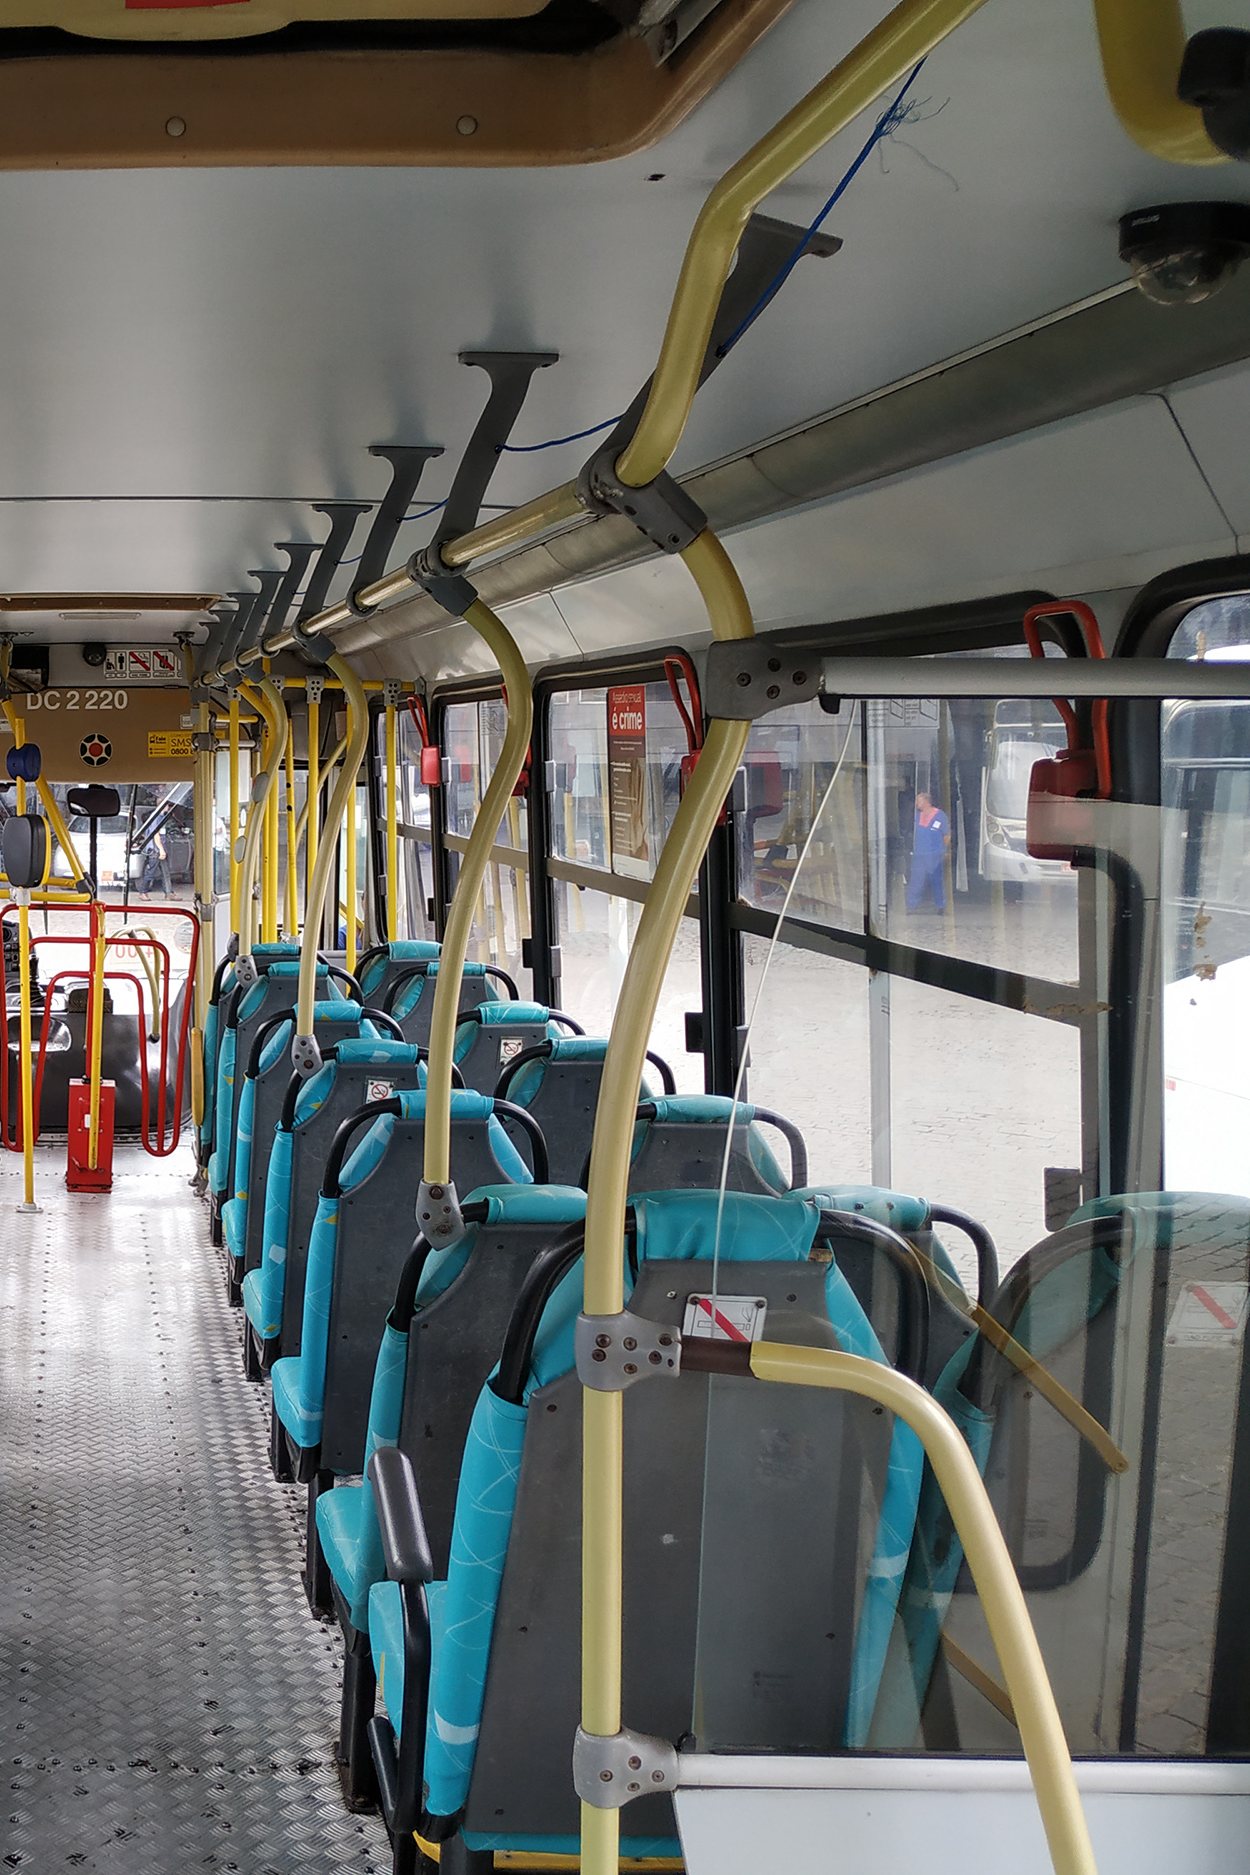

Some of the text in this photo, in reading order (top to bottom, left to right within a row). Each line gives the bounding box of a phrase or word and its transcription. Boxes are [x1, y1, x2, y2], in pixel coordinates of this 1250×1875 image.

[26, 690, 60, 710] DC
[612, 706, 642, 730] é crime
[171, 738, 192, 748] SMS
